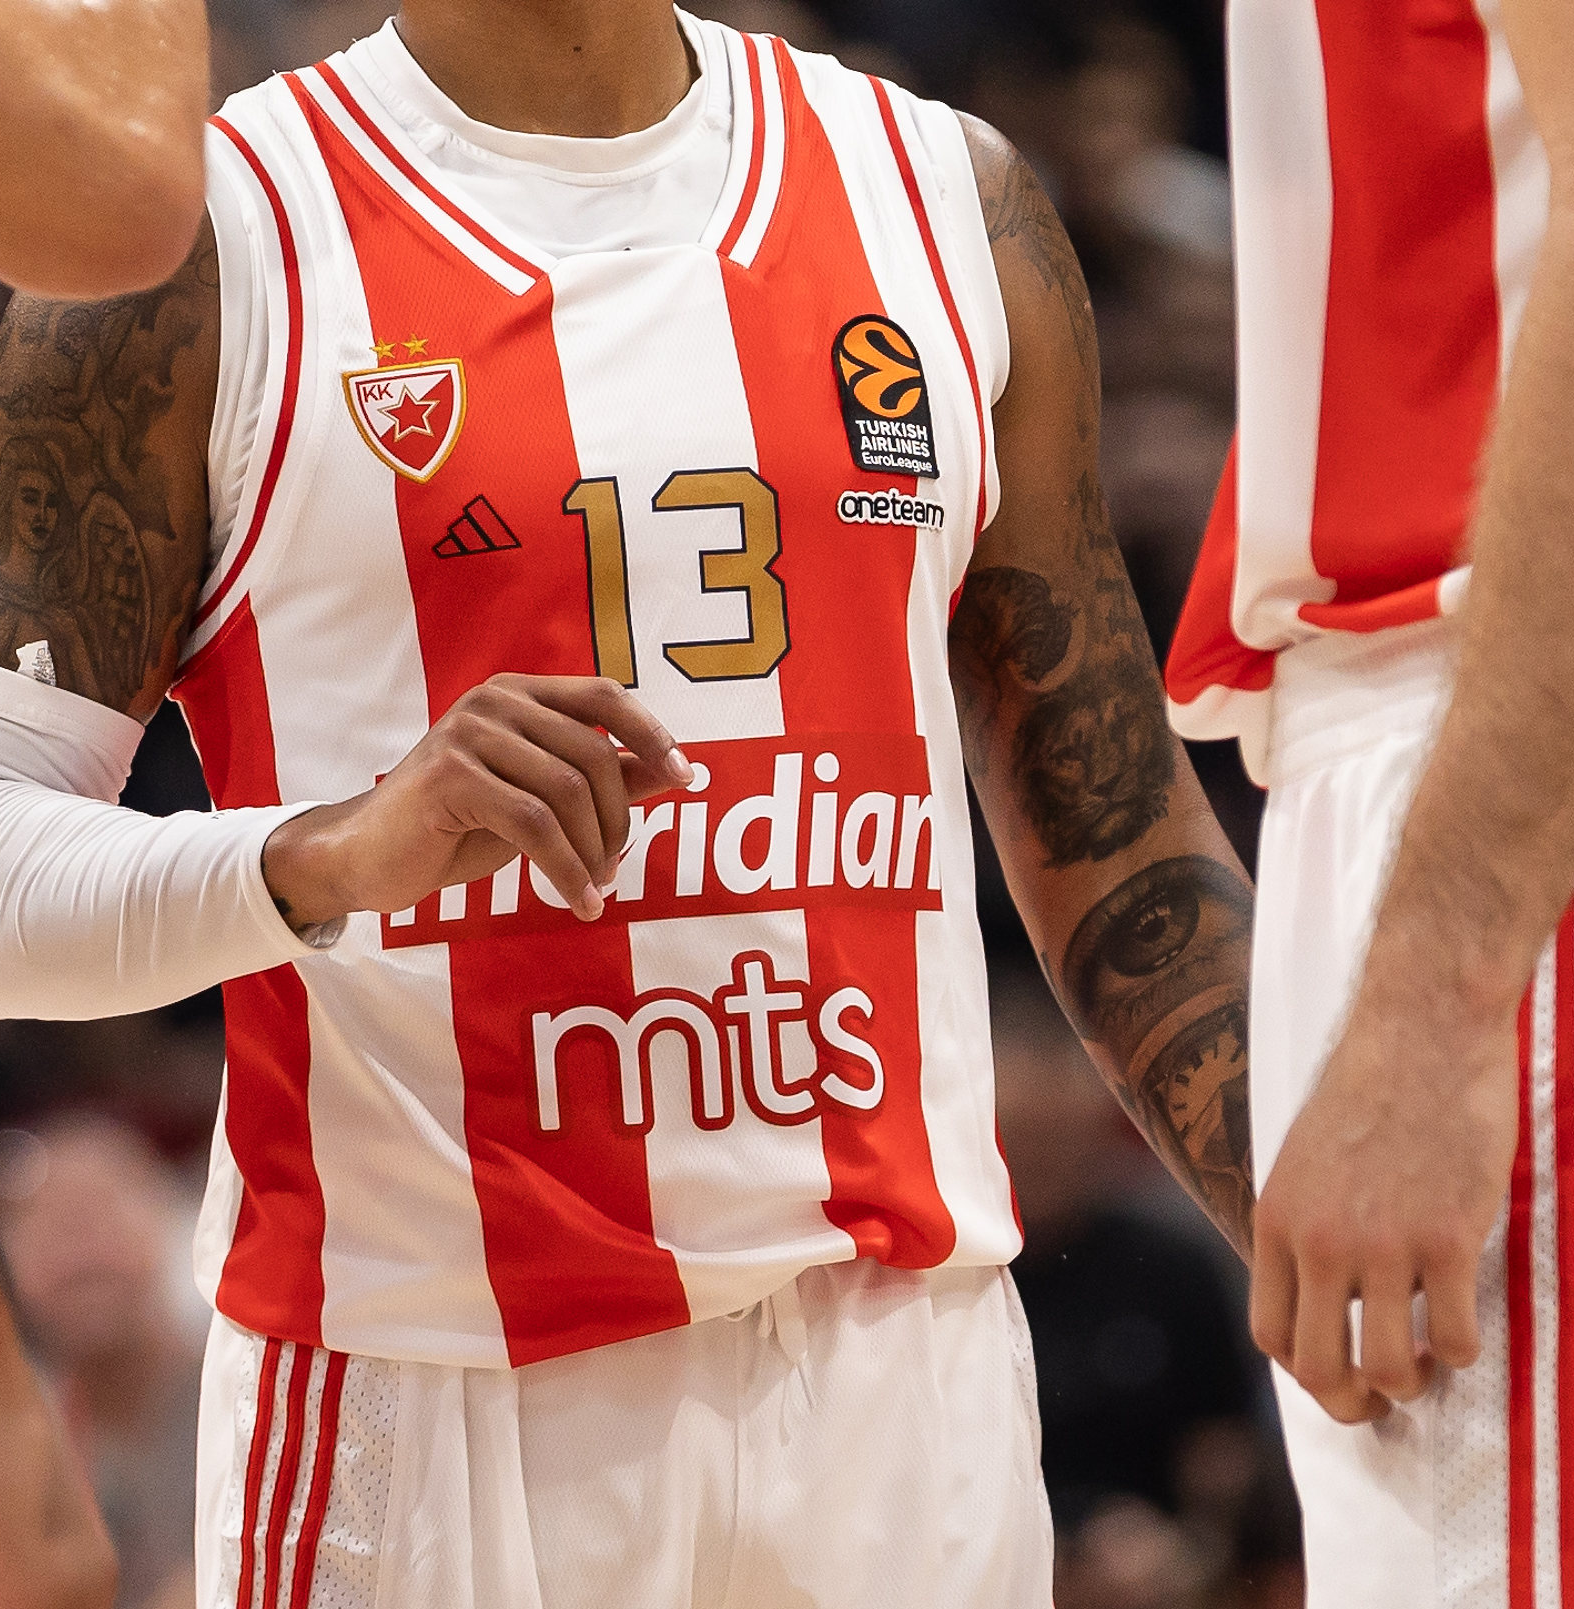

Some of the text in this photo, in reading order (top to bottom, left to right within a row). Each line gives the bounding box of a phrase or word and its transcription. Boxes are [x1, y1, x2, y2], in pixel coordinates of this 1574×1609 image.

[362, 382, 394, 404] KK
[855, 419, 929, 441] TURKISH
[860, 436, 931, 458] AIRLINES
[861, 451, 934, 473] EuroLeague
[839, 492, 946, 529] oneteam
[561, 466, 792, 690] 13
[389, 751, 943, 928] ridian
[531, 960, 886, 1132] mts
